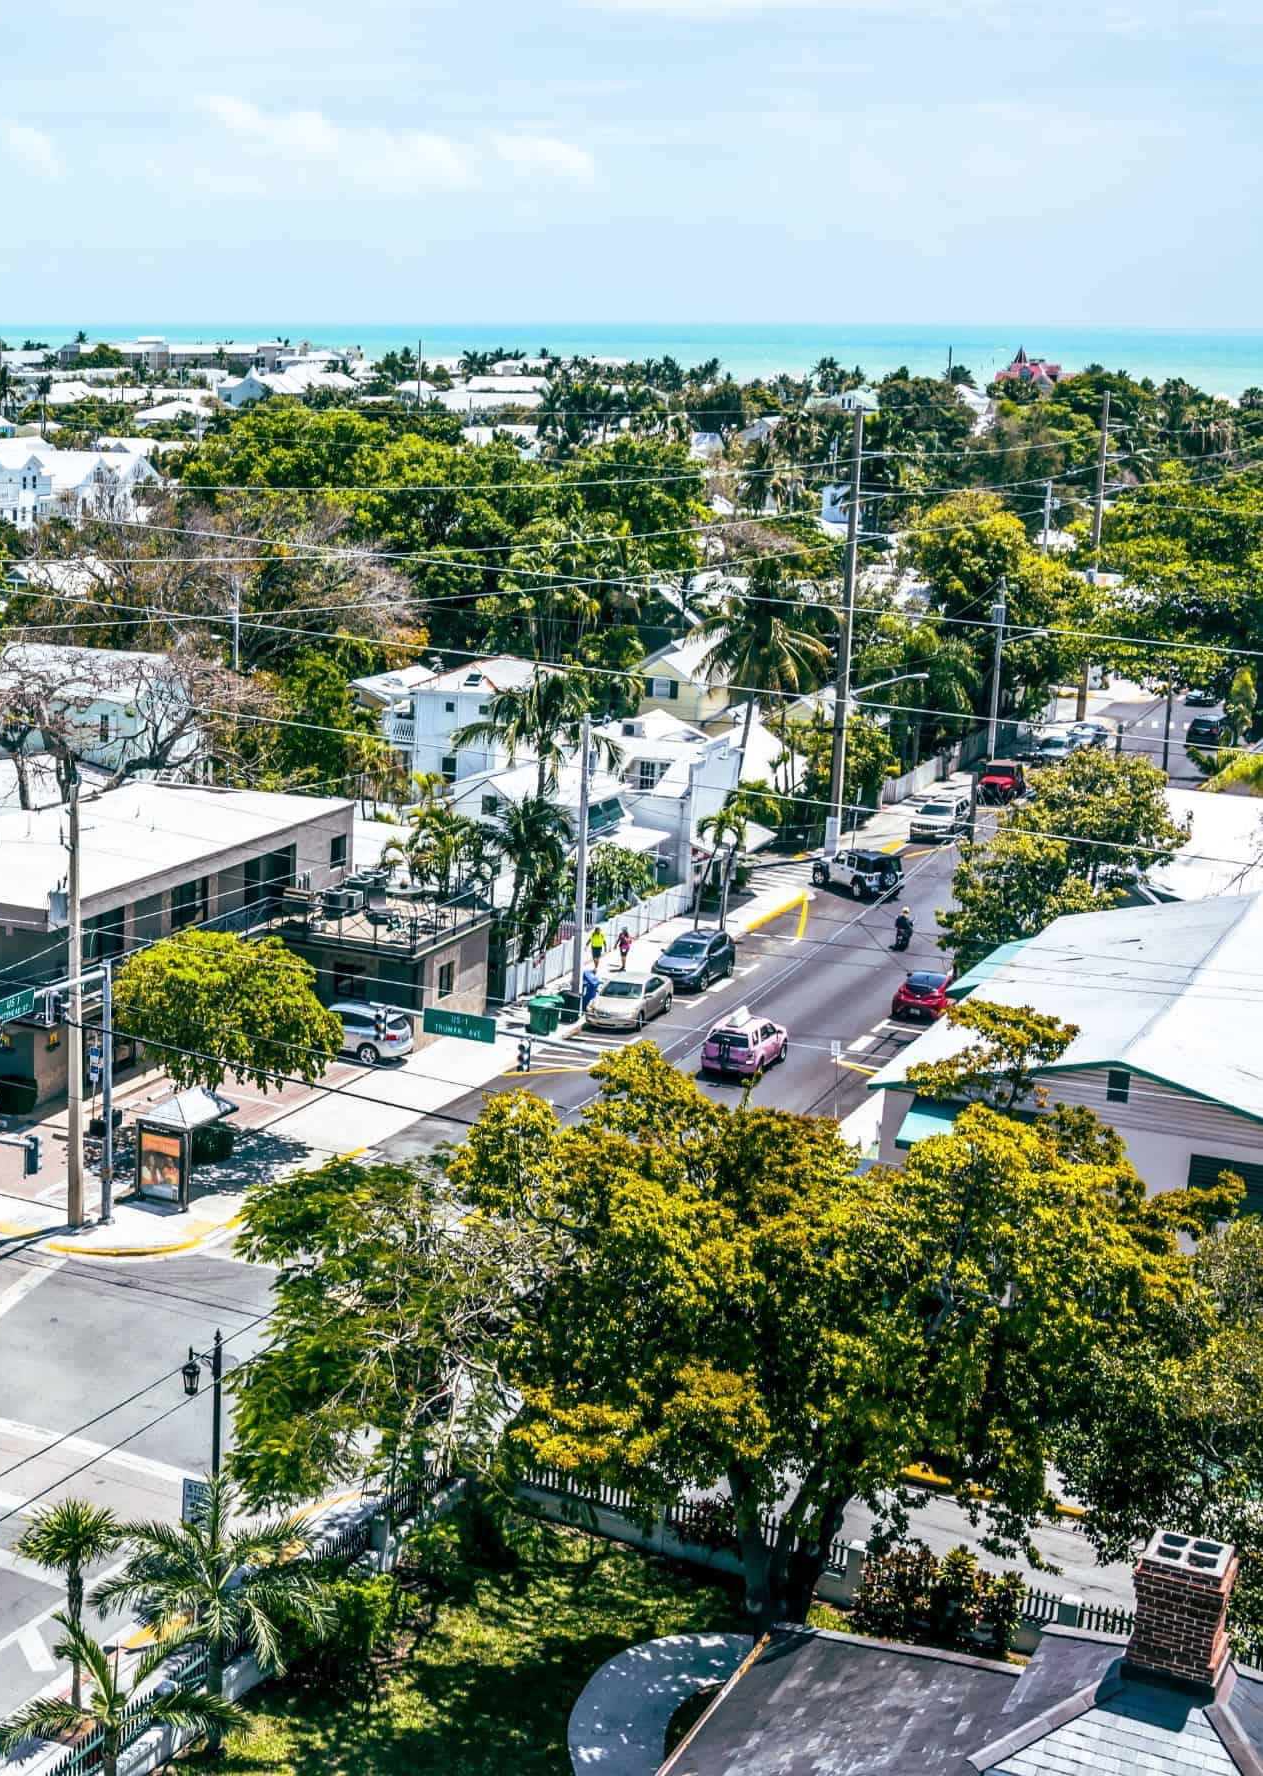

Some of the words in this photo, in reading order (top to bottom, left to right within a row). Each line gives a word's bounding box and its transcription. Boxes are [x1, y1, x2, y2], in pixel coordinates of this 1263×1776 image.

[6, 998, 16, 1009] US
[435, 1023, 463, 1035] TRUMAN
[468, 1029, 482, 1040] AVE
